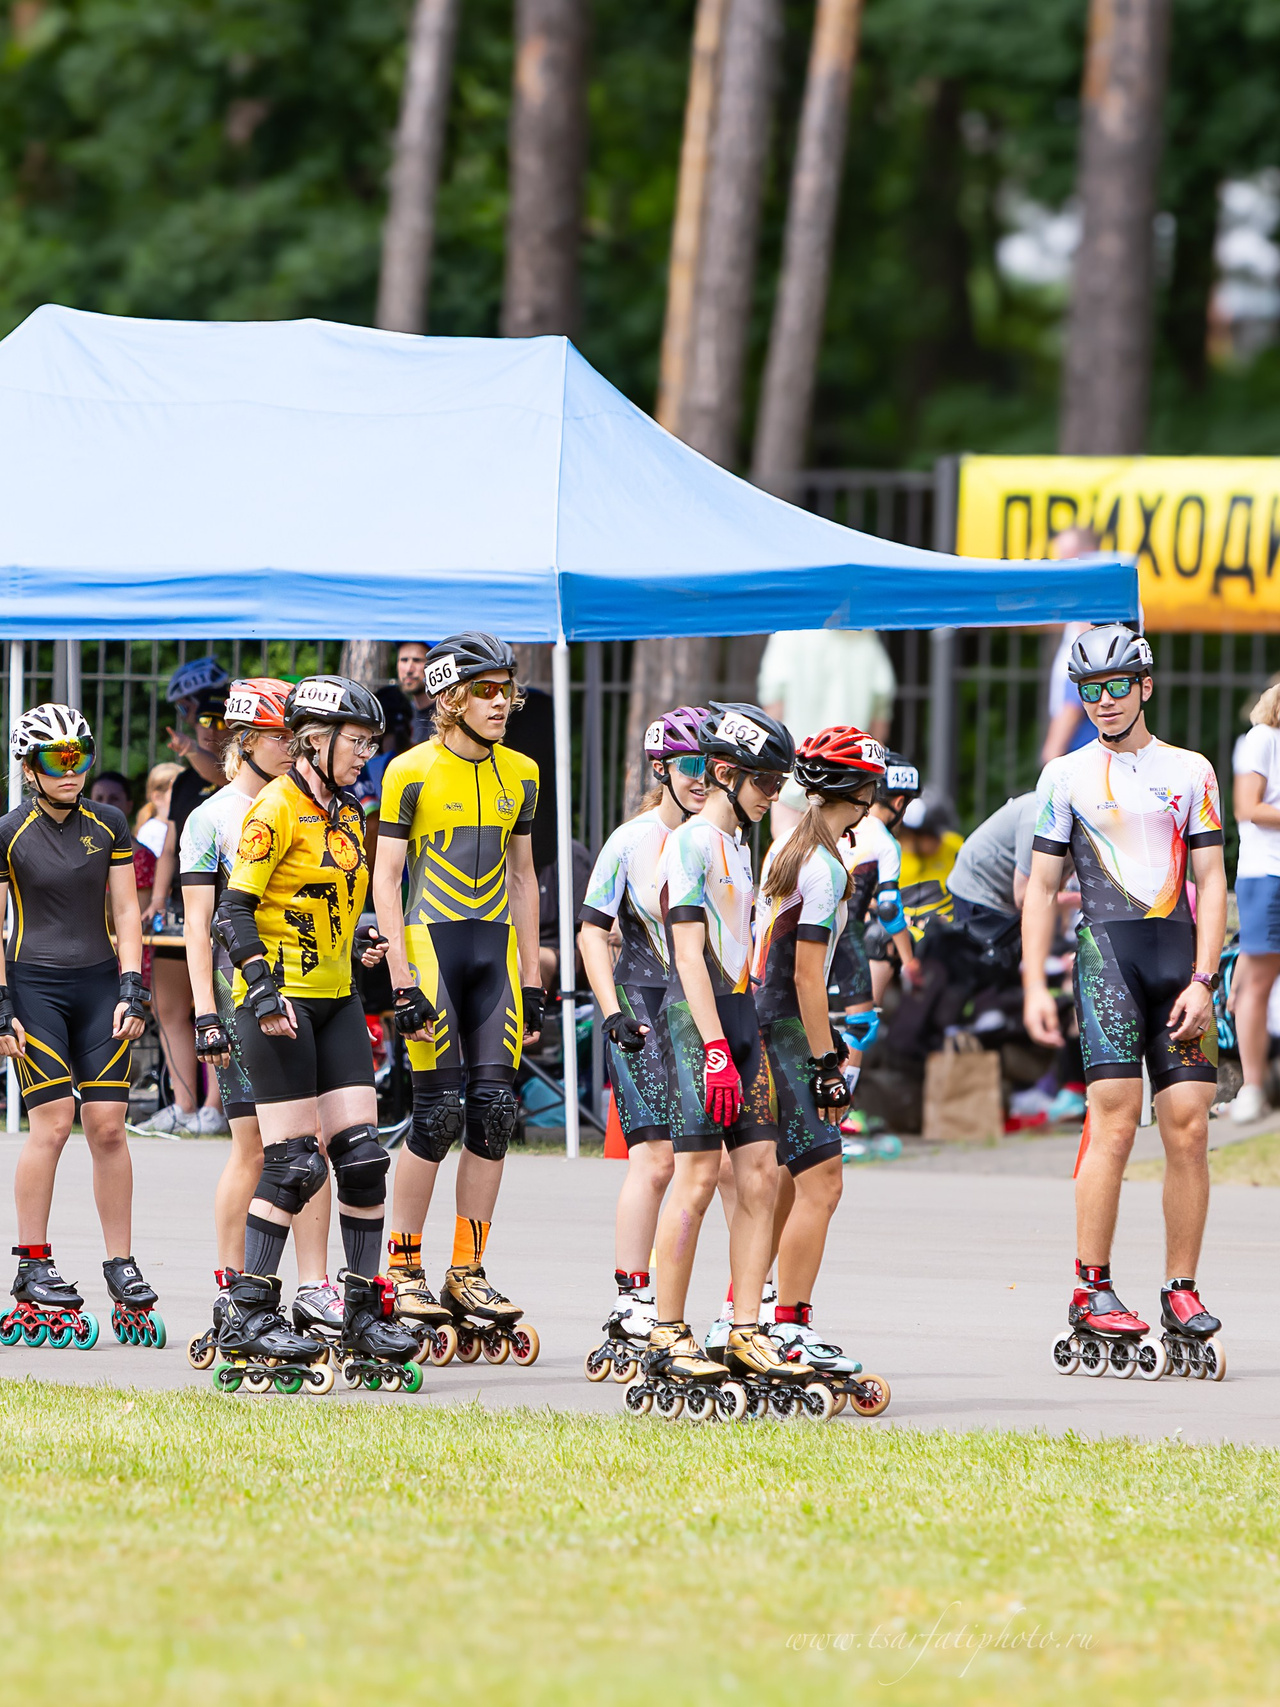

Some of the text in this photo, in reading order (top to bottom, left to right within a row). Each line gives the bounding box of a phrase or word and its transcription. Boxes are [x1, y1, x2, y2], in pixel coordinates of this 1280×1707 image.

[428, 662, 453, 687] 656
[298, 687, 338, 705] 1001
[228, 699, 252, 715] 612
[724, 720, 760, 746] 662
